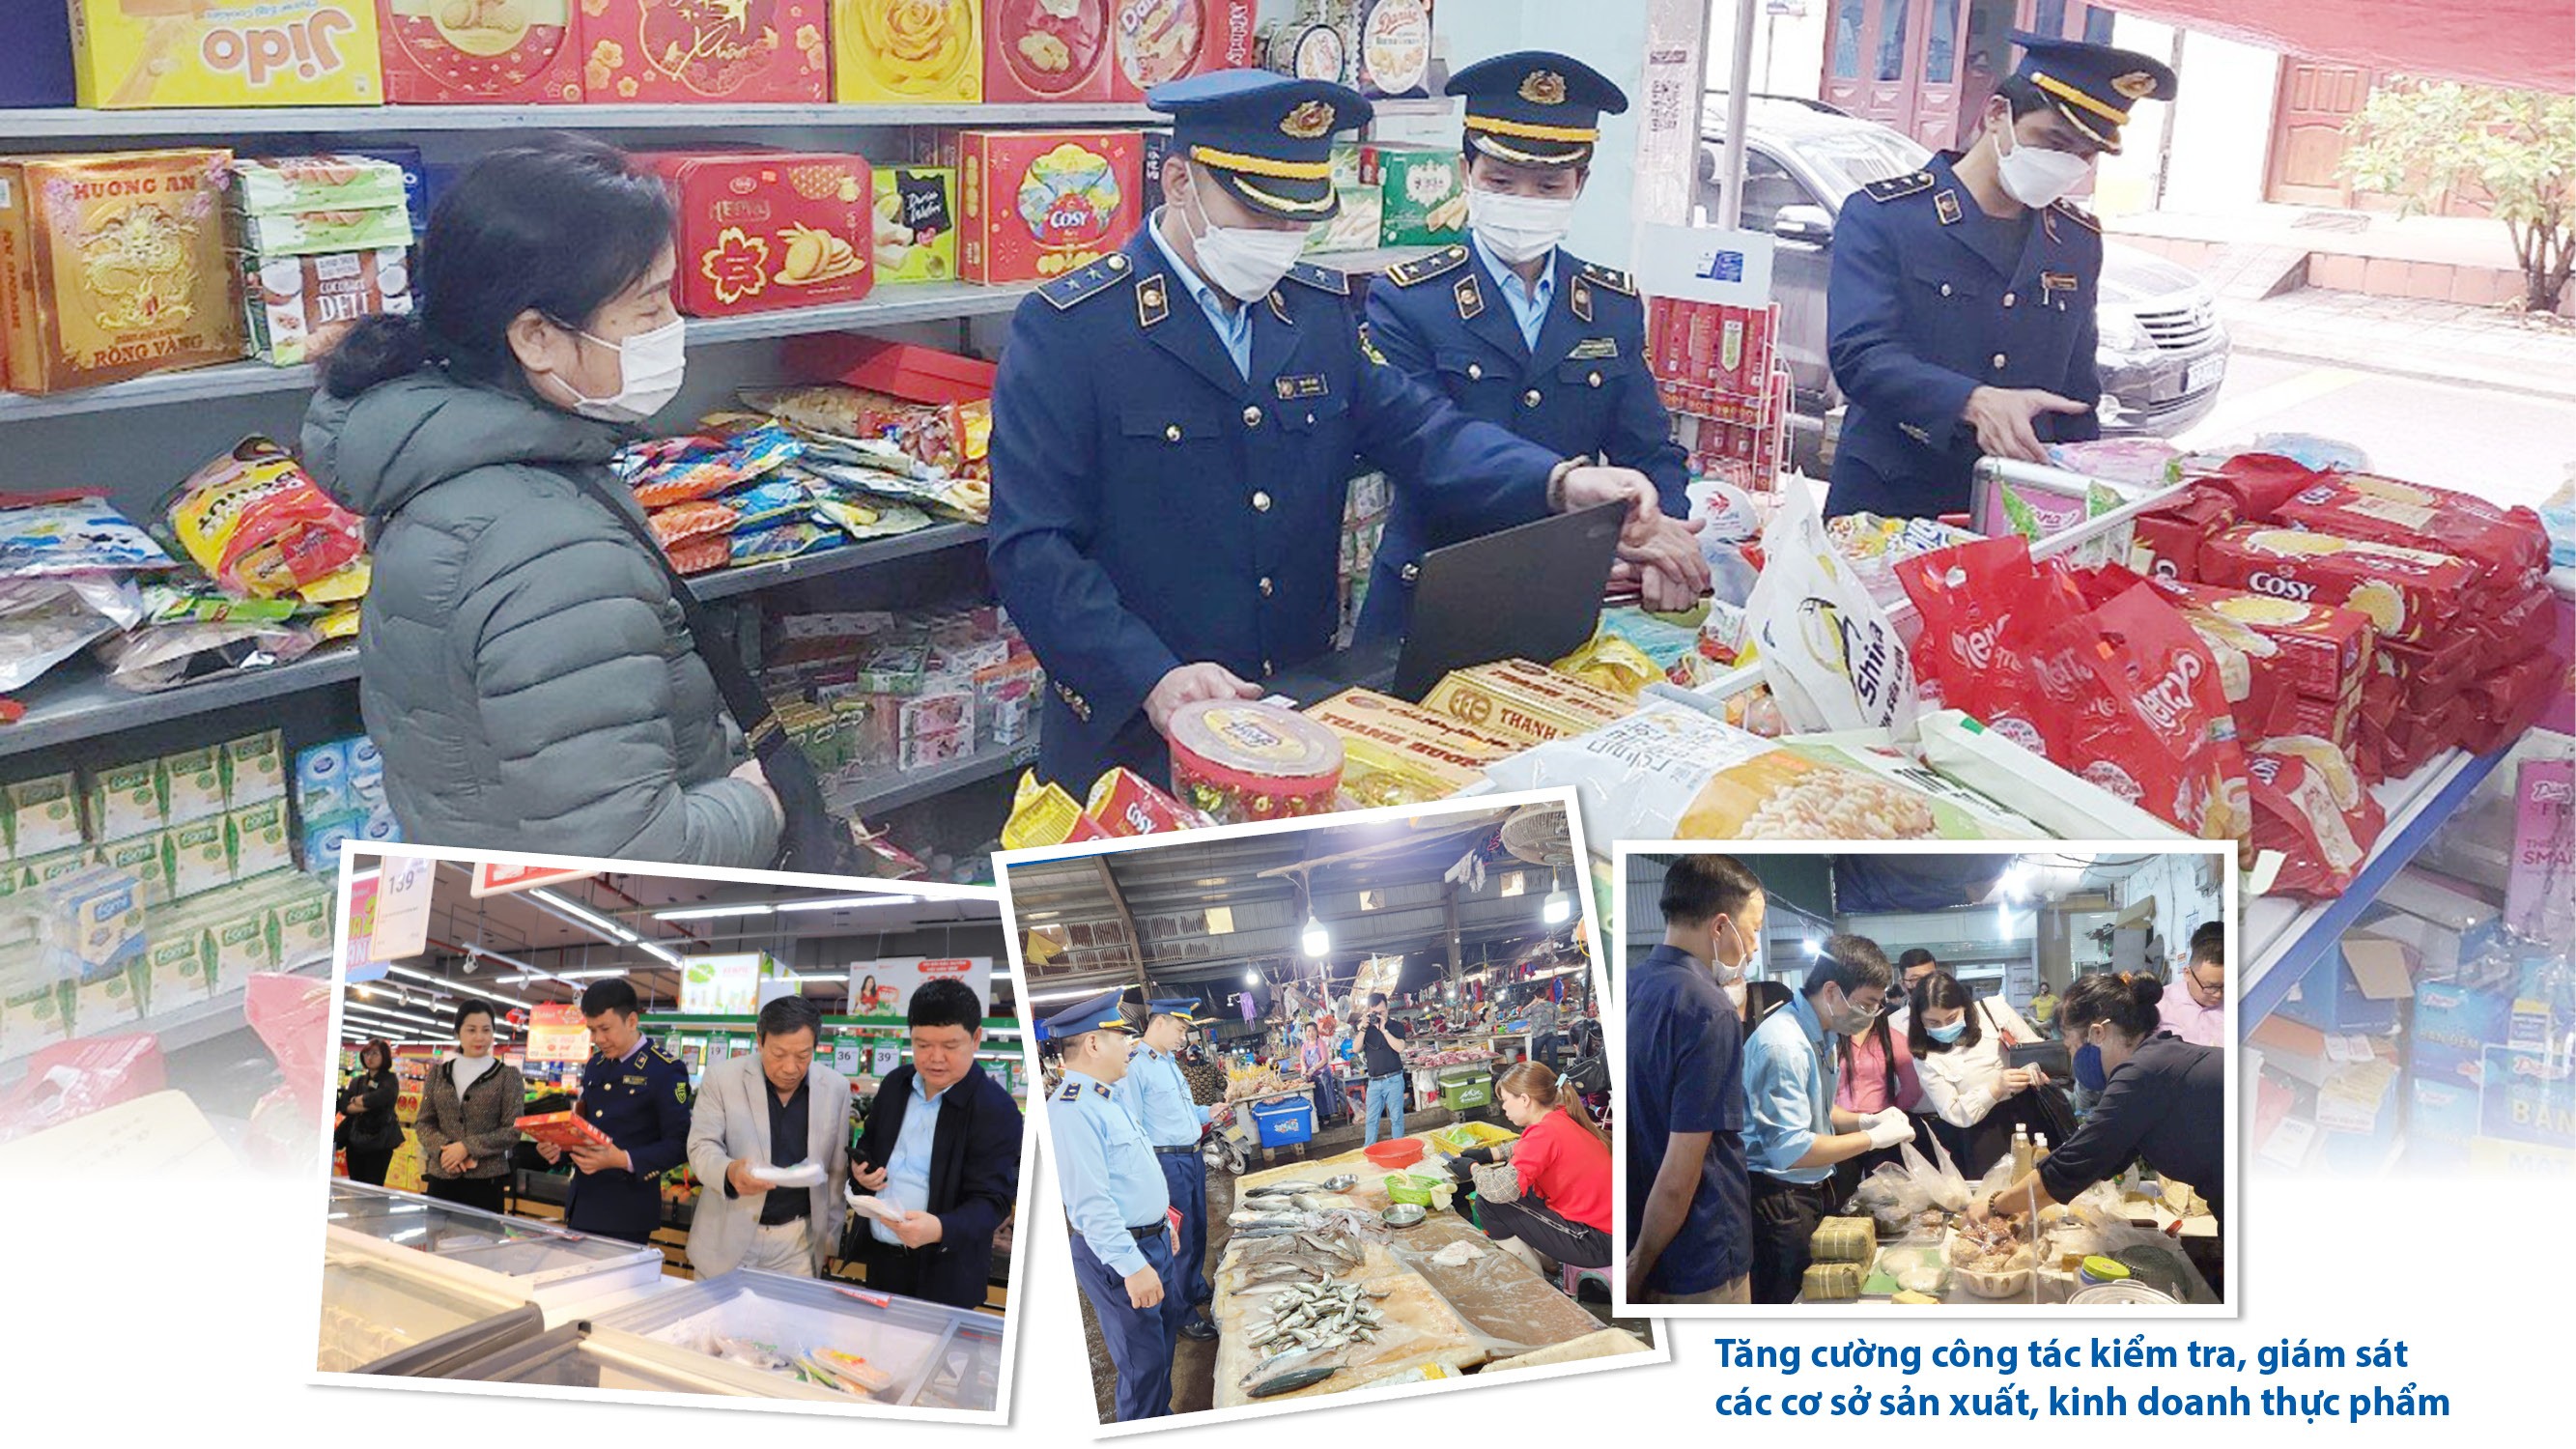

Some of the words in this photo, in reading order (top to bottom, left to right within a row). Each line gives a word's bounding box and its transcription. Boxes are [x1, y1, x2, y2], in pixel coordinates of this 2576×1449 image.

[203, 9, 353, 84] Jido
[1049, 210, 1090, 229] COSY
[2247, 571, 2317, 602] COSY
[1500, 707, 1559, 741] THANH
[388, 869, 415, 895] 139
[710, 1046, 722, 1056] 19
[836, 1050, 852, 1062] 36
[877, 1052, 892, 1063] 39
